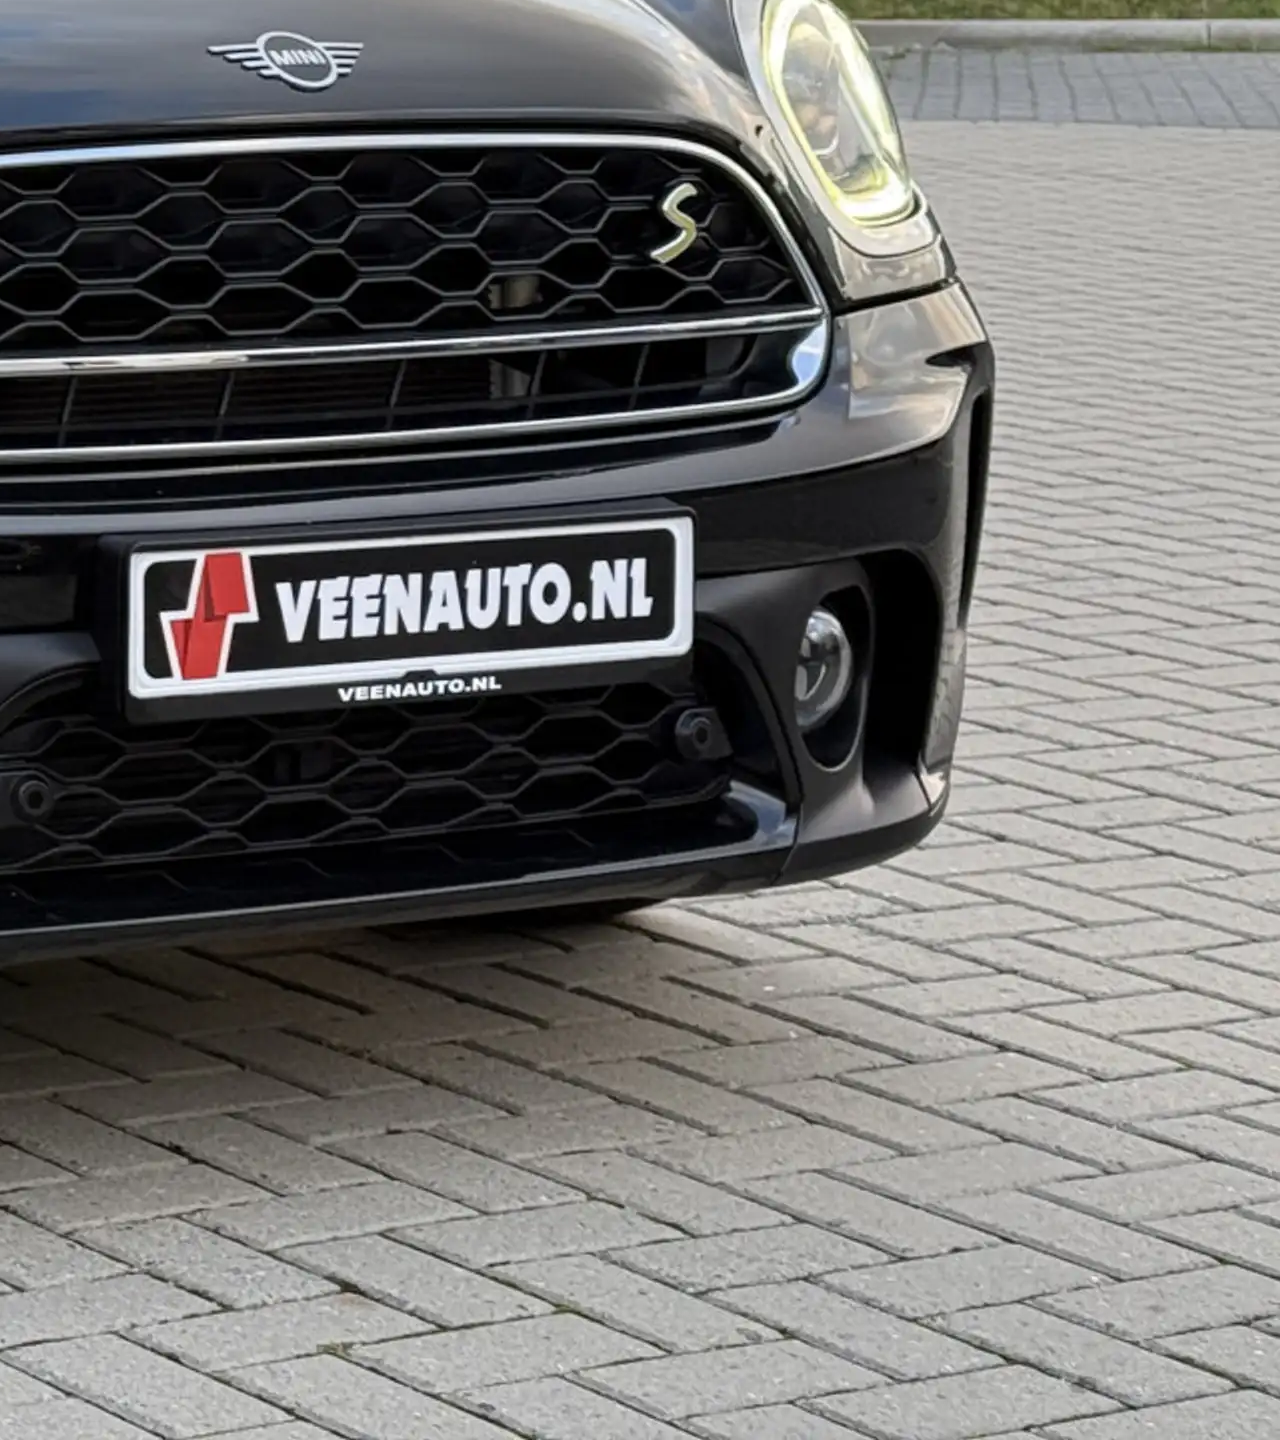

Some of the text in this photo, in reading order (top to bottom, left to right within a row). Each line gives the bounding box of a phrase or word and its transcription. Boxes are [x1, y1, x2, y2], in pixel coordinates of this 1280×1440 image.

[268, 49, 327, 66] MINI
[650, 182, 698, 264] S
[275, 558, 653, 643] VEENAUTO.NL
[338, 675, 502, 702] VEENAUTO.NL
